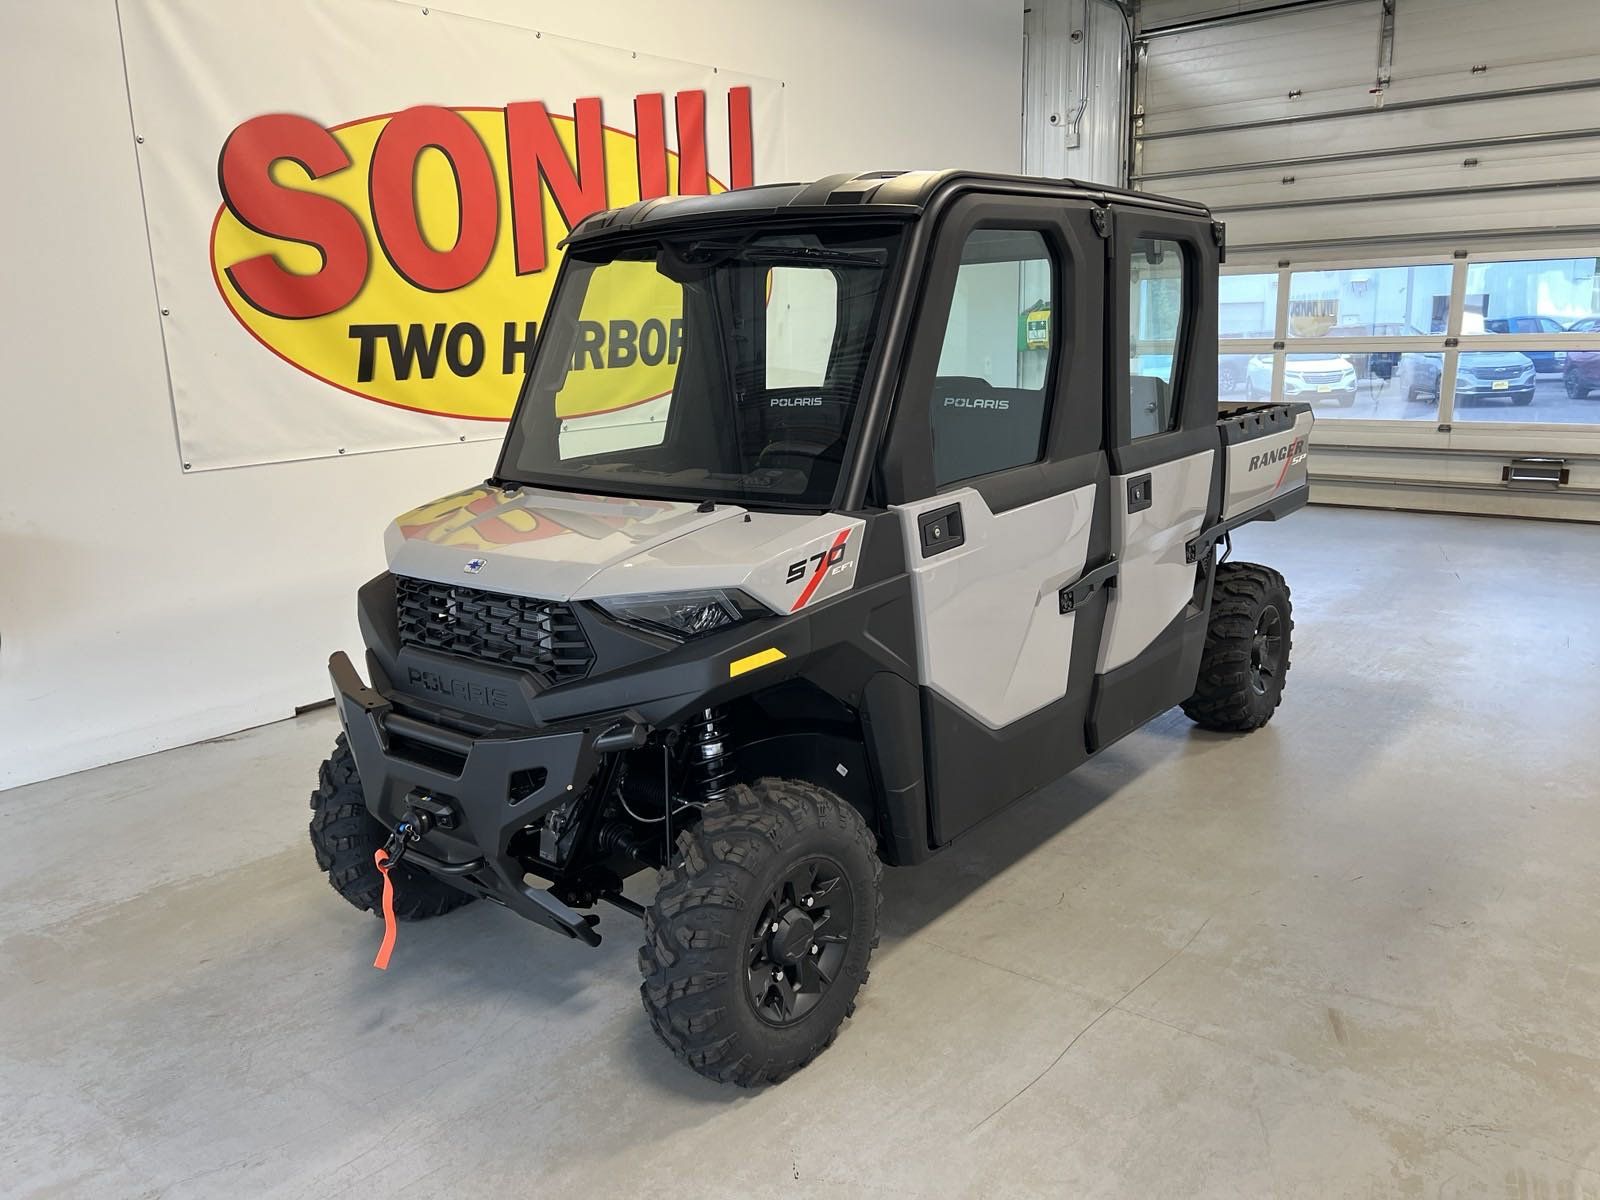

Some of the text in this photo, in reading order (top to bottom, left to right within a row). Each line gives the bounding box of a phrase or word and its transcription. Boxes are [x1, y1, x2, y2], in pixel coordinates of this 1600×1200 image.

[348, 321, 485, 382] TWO
[770, 397, 823, 407] POLARIS
[943, 397, 1010, 410] POLARIS
[1247, 439, 1305, 473] RANGER
[1290, 452, 1307, 466] SP
[785, 542, 847, 585] 570
[831, 560, 854, 576] EFI
[407, 666, 509, 711] POLARIS
